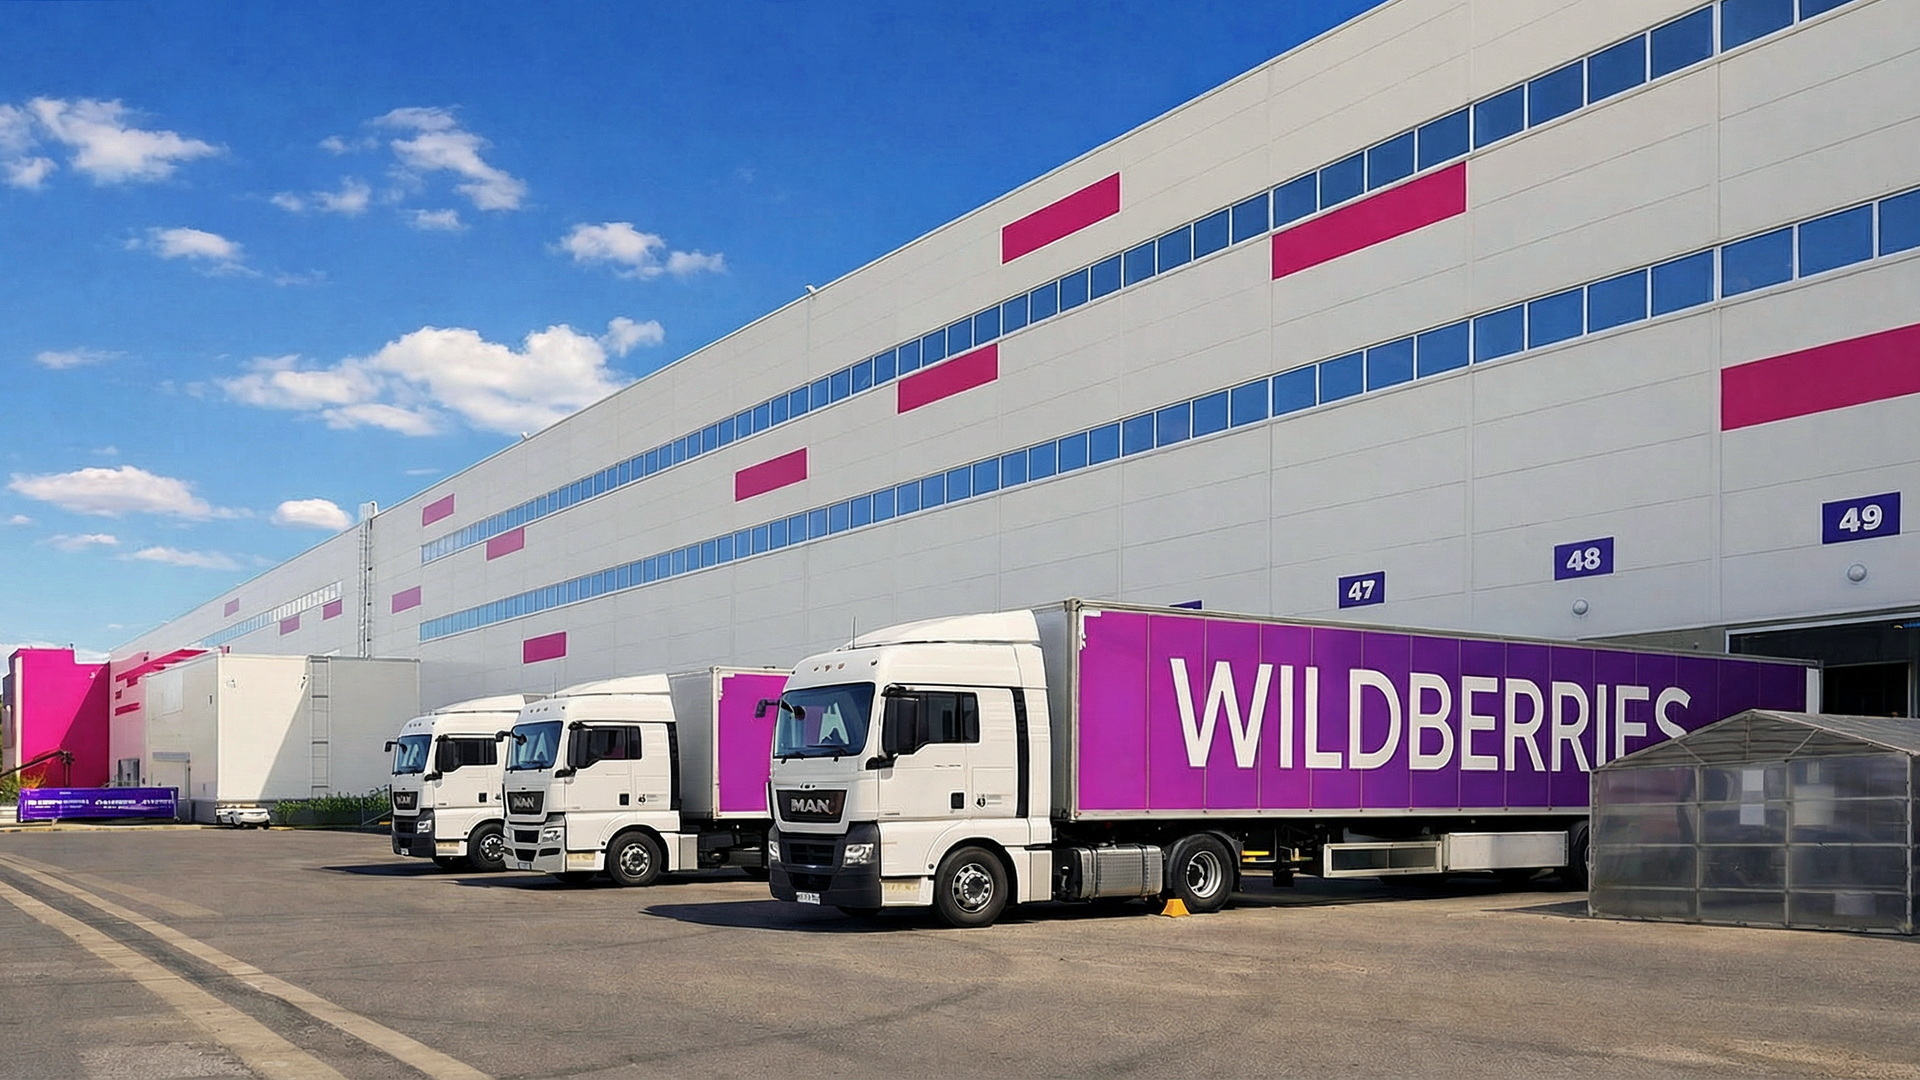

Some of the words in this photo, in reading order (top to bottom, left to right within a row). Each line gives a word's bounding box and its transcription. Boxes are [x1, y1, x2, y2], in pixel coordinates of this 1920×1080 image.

[1839, 504, 1883, 532] 49
[1566, 547, 1601, 571] 48
[1348, 580, 1375, 601] 47
[1169, 657, 1692, 773] WILDBERRIES
[790, 798, 829, 814] MAN
